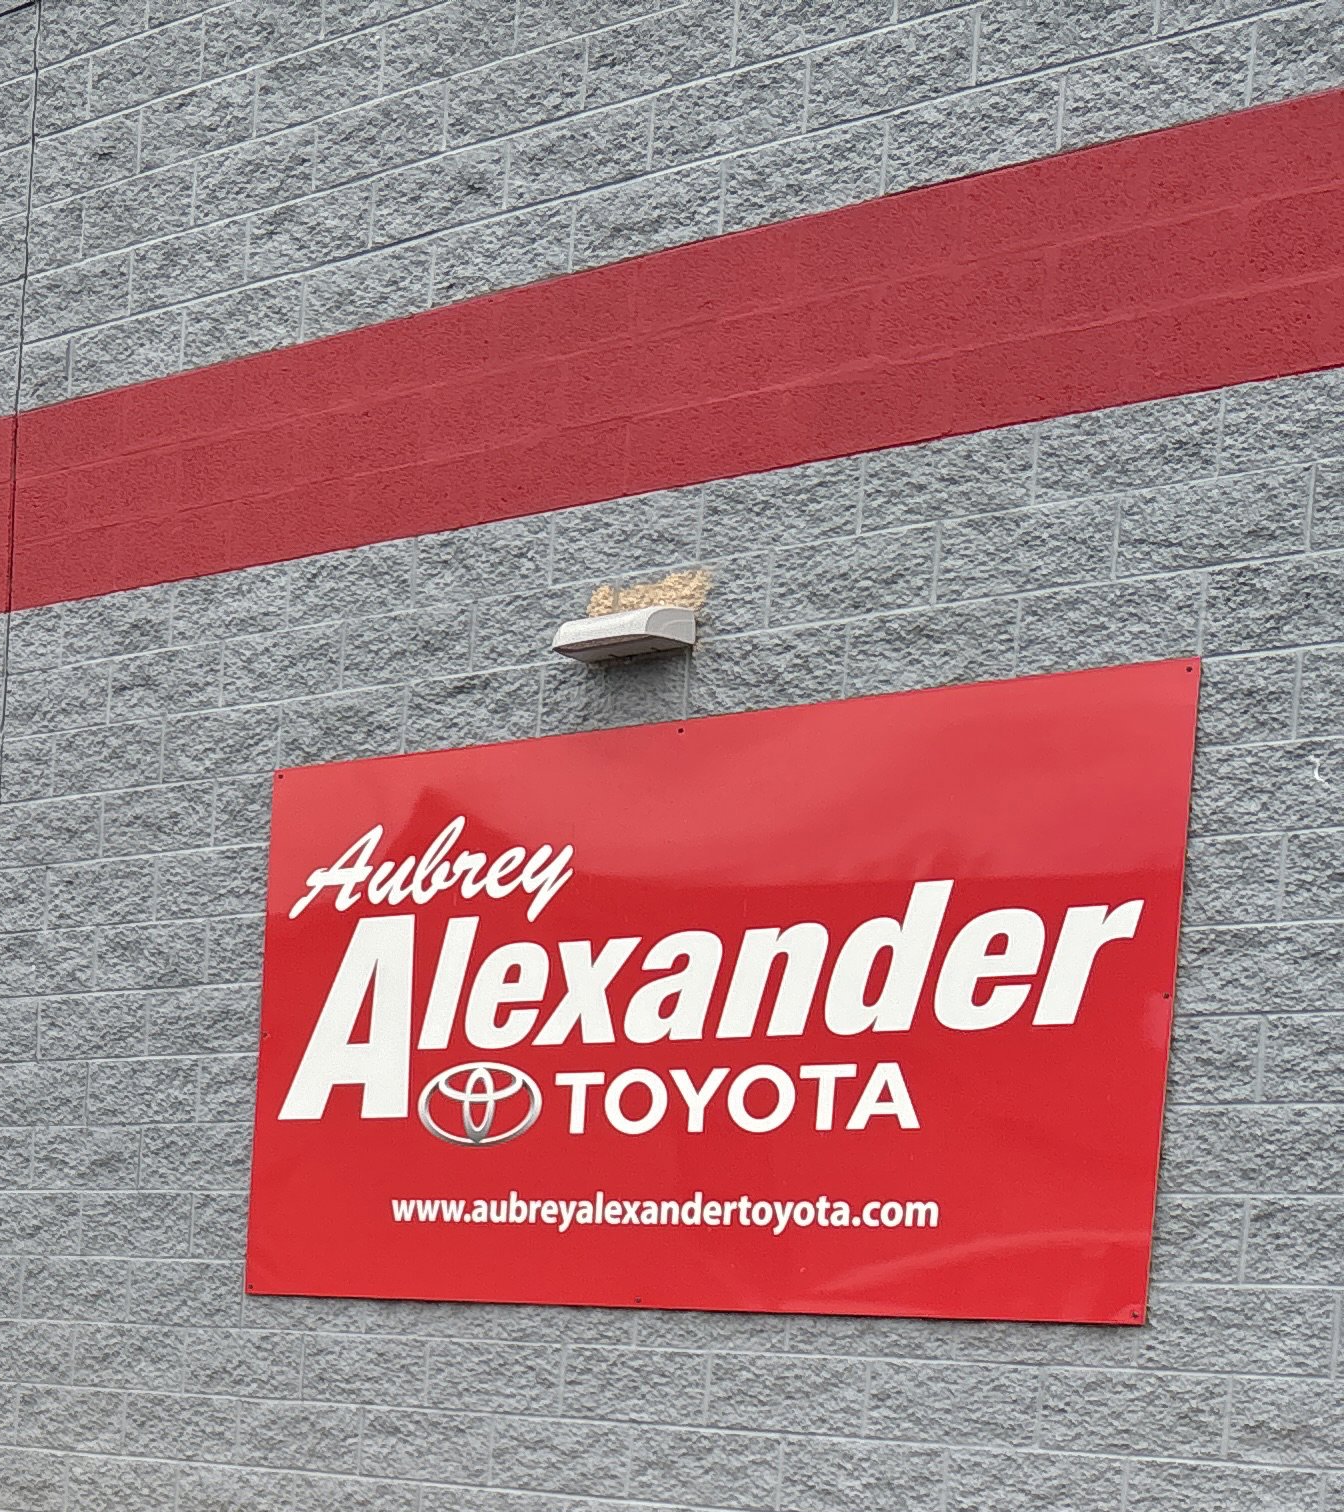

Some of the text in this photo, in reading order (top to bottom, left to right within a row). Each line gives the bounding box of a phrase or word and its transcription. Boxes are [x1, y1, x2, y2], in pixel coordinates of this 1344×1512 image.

[288, 815, 574, 923] Aubrey
[277, 880, 1145, 1121] Alexander
[555, 1063, 920, 1136] TOYOTA
[392, 1190, 940, 1236] www.aubreyalexandertoyota.com
